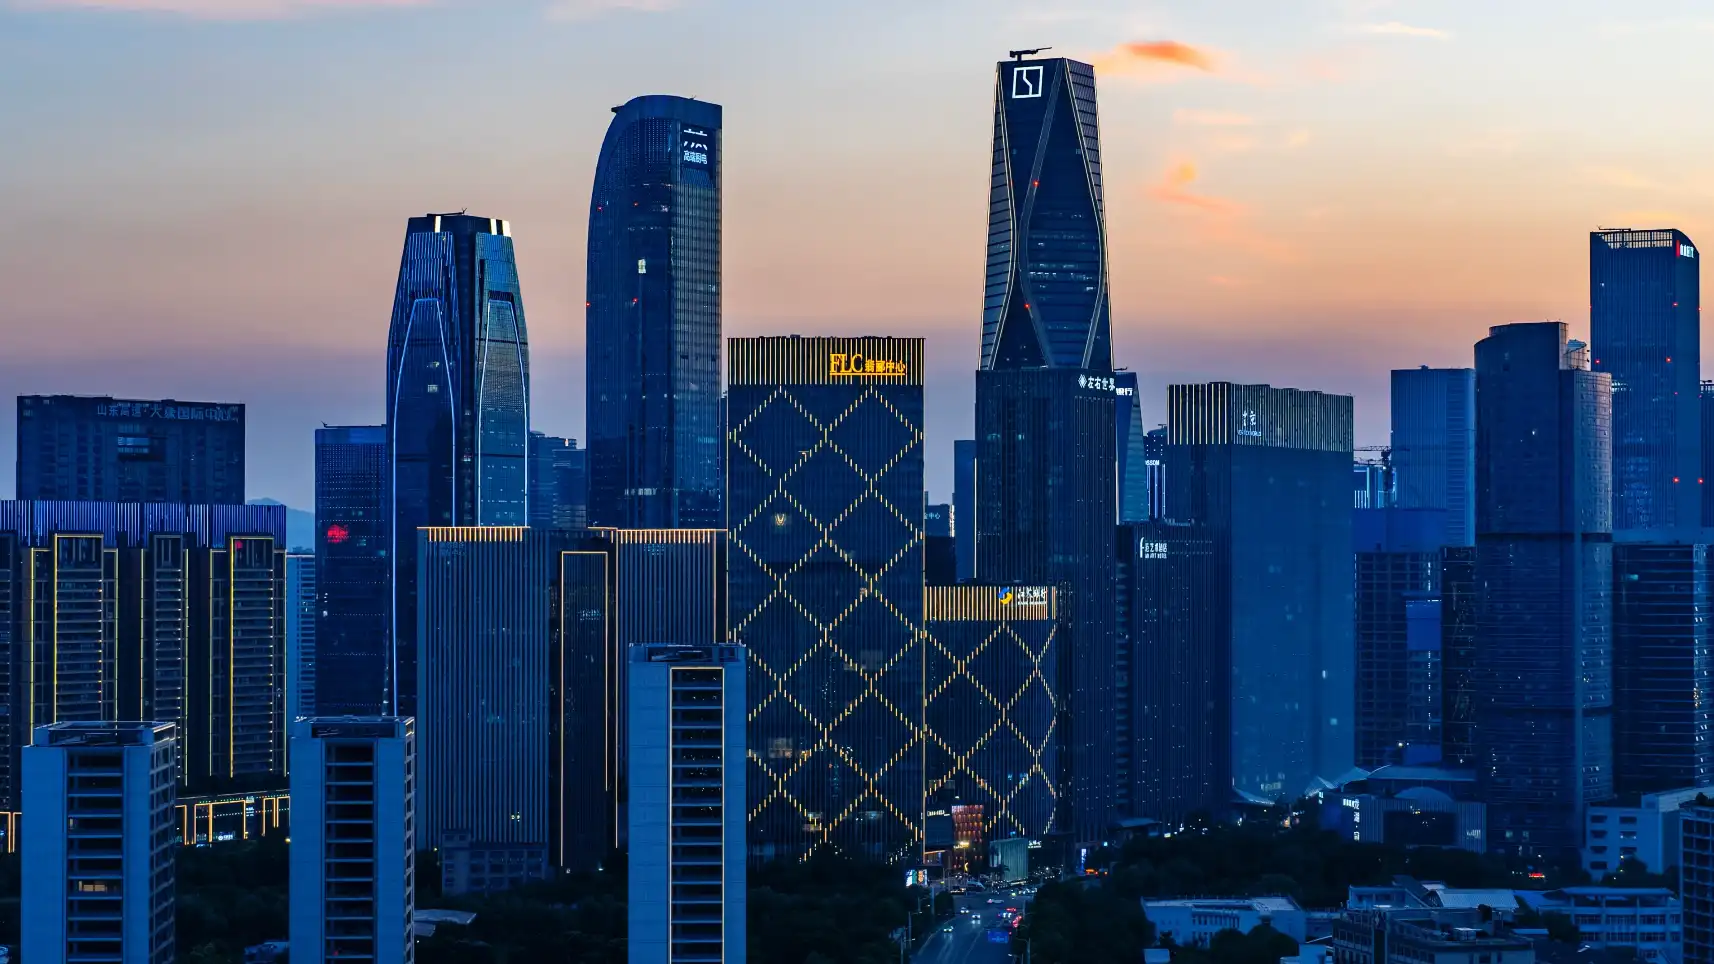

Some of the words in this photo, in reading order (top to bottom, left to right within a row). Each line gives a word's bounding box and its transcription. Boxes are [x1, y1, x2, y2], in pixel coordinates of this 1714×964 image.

[829, 353, 863, 373] FLC
[1087, 375, 1116, 391] 左右世界
[1115, 387, 1133, 396] 银行
